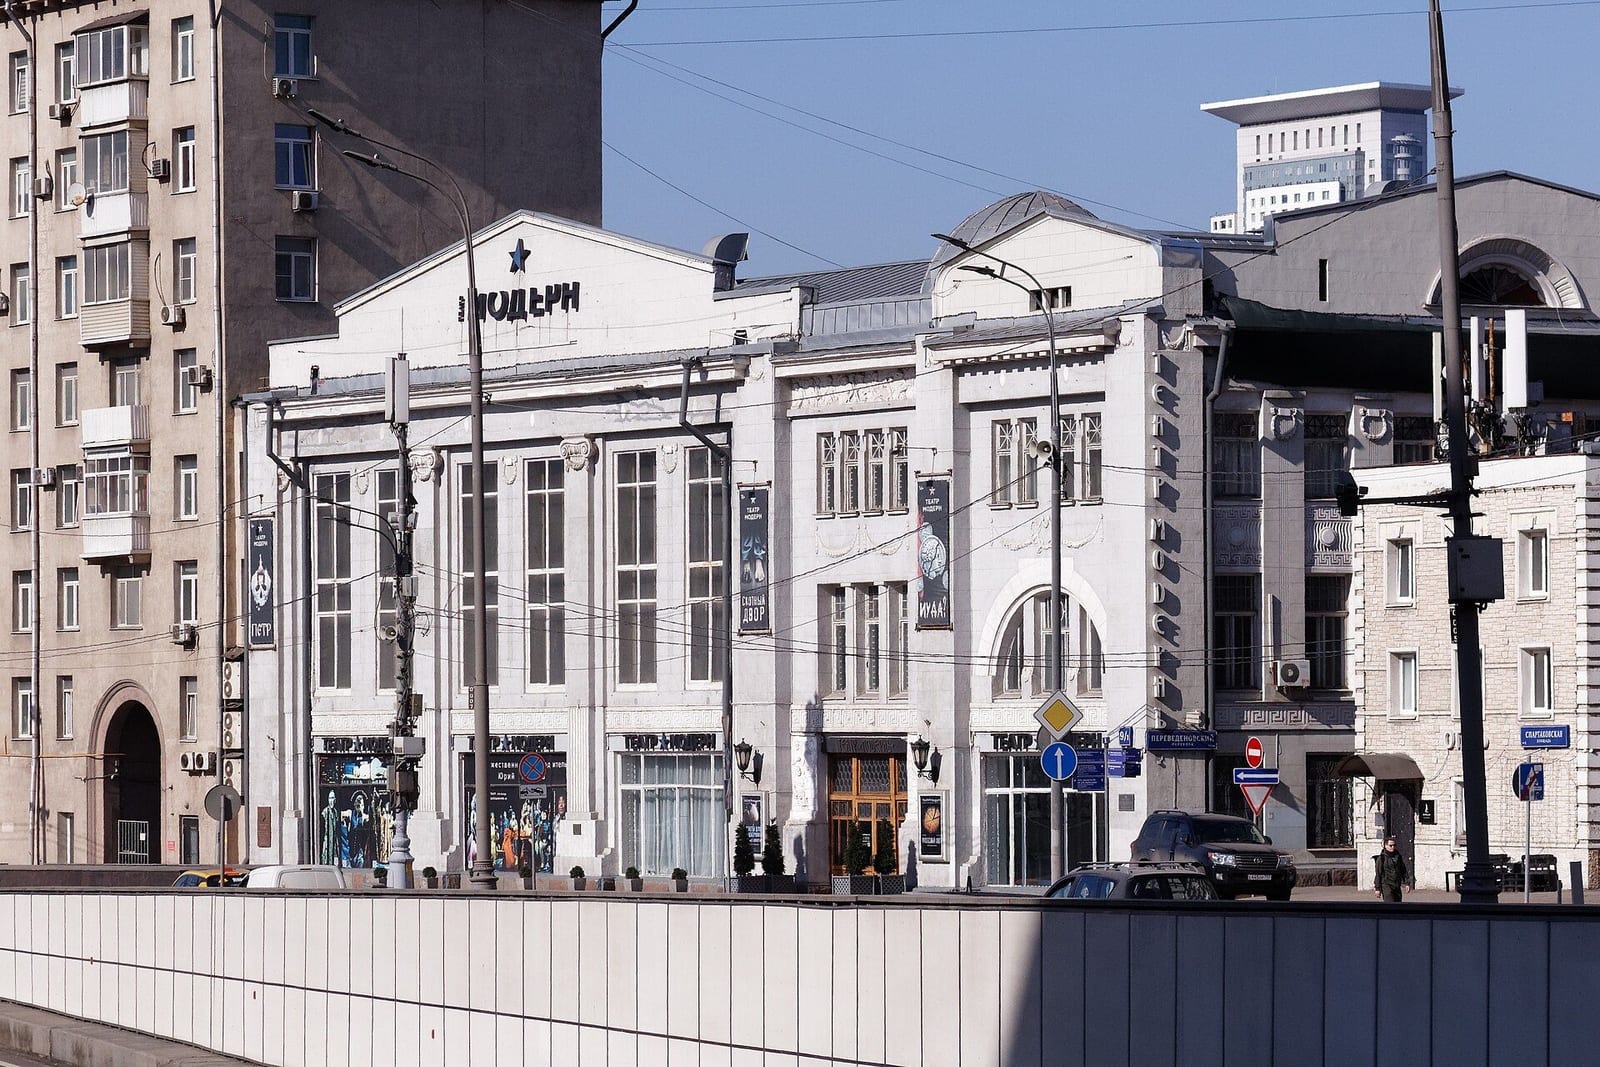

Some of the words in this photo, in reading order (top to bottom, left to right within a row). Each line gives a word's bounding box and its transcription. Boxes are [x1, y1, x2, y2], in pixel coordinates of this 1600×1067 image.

[742, 606, 765, 624] ДВОР
[1525, 730, 1563, 739] СПАРТАКОВСКАЯ
[990, 734, 1034, 752] ТЕАТР
[498, 772, 515, 780] Юрий
